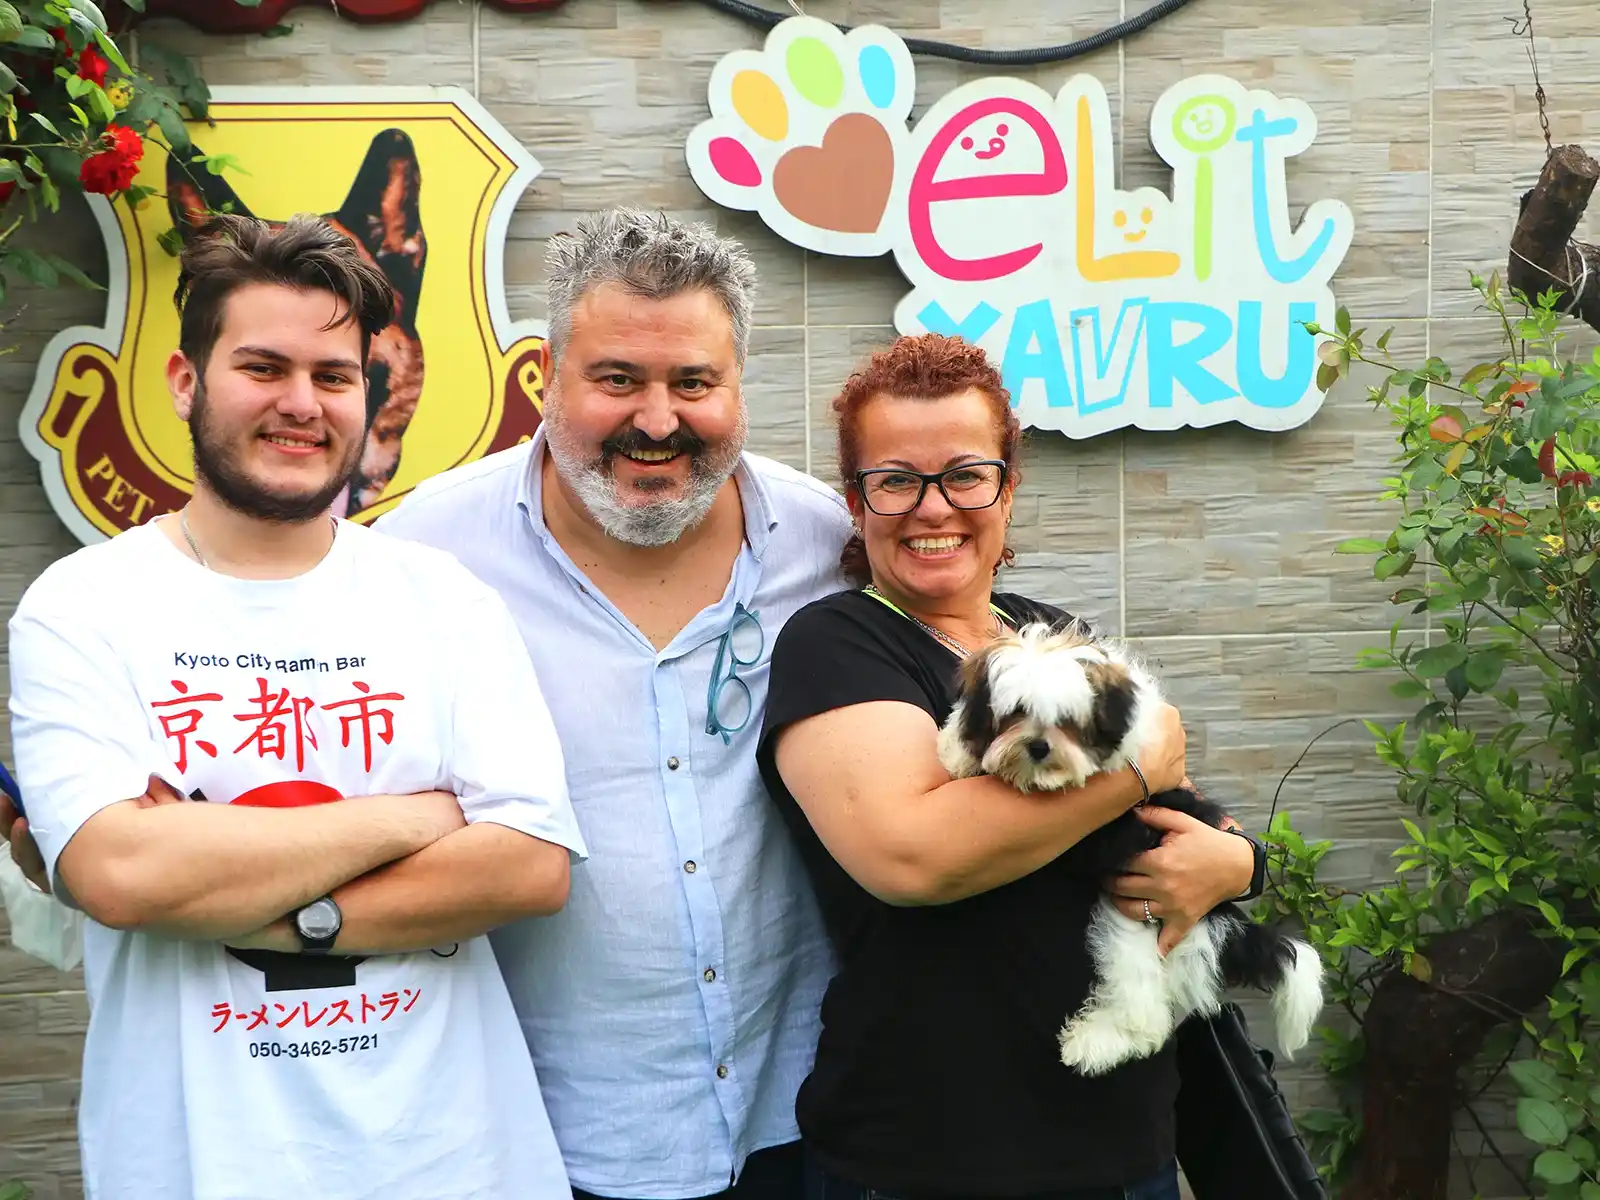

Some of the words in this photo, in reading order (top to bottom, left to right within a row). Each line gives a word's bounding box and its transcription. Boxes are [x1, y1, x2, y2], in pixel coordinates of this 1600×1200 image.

[83, 453, 155, 525] PET
[174, 652, 229, 670] Kyoto
[236, 653, 271, 670] City
[275, 657, 329, 673] Ramn
[336, 656, 366, 670] Bar
[151, 677, 405, 774] 京都市
[211, 988, 421, 1033] ラーメンレストラン
[249, 1033, 379, 1058] 050-3462-5721
